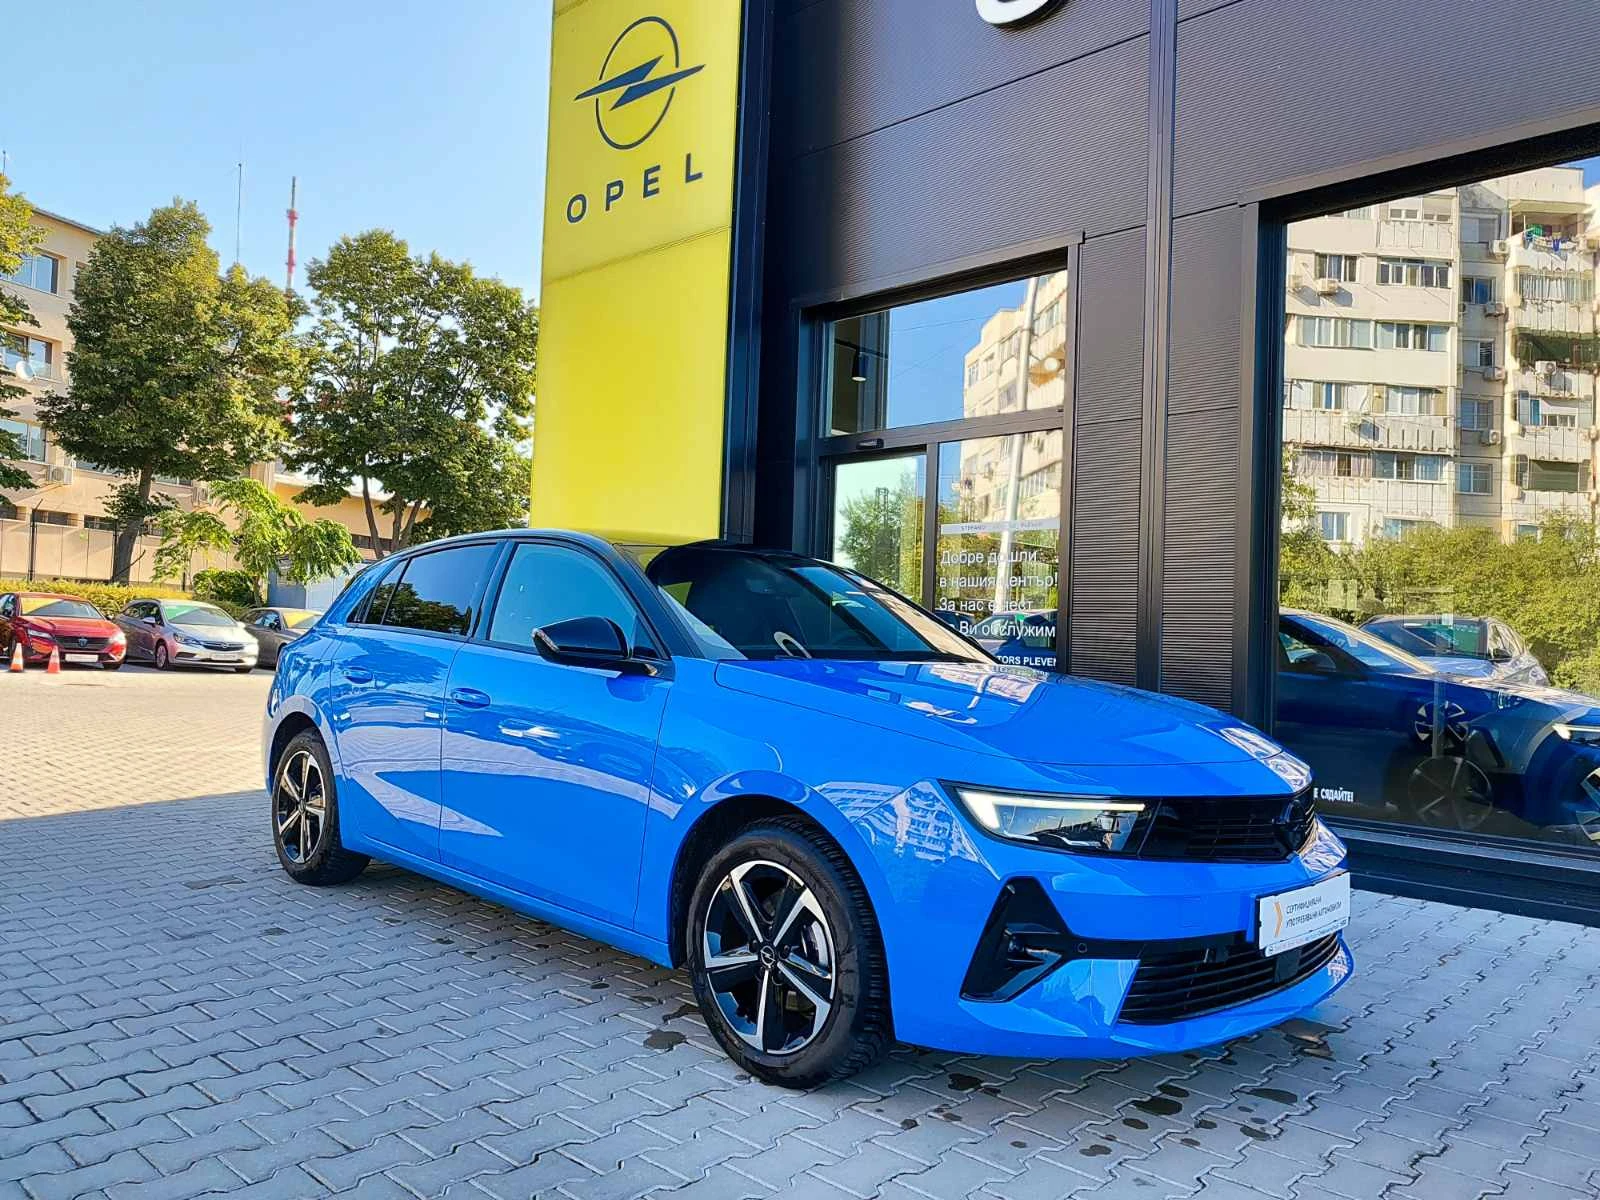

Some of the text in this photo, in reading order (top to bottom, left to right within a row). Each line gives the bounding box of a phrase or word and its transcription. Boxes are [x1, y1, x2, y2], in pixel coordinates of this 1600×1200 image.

[566, 152, 703, 224] OPEL
[941, 550, 984, 566] Добре
[939, 572, 1058, 588] в нашия ентър!
[939, 596, 955, 611] За
[960, 599, 984, 611] нас
[959, 620, 977, 636] Ви
[996, 655, 1021, 665] TORS
[1320, 787, 1354, 803] СЯДАЙТЕ!
